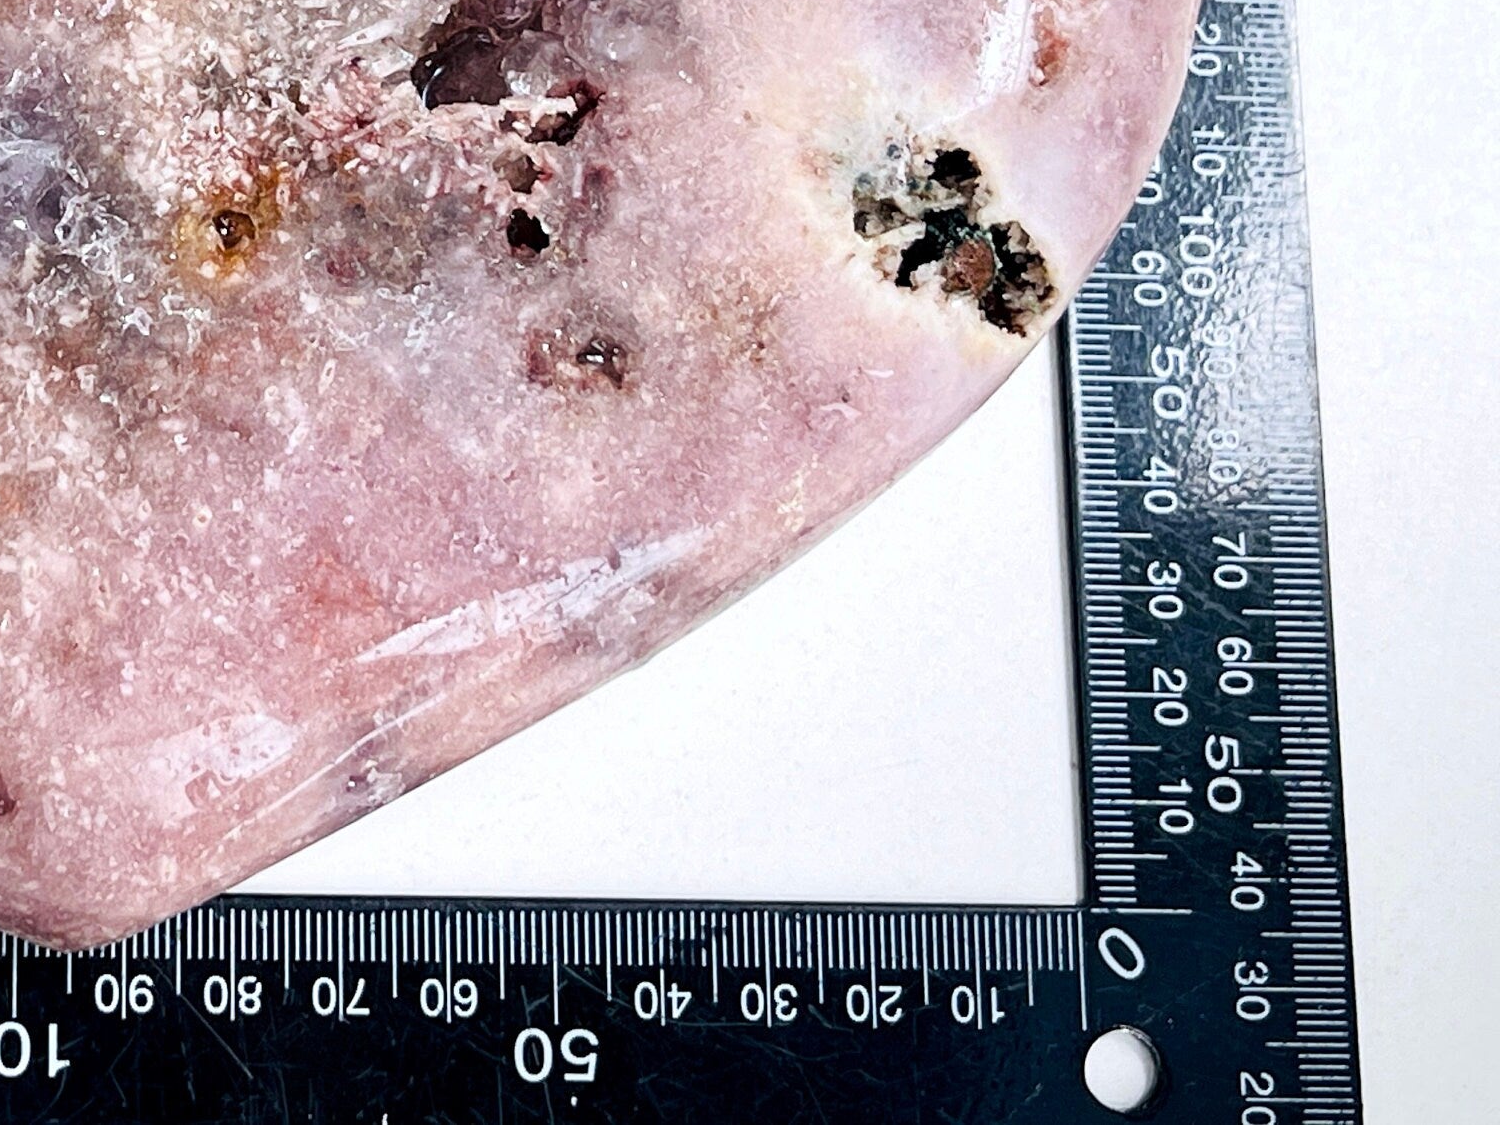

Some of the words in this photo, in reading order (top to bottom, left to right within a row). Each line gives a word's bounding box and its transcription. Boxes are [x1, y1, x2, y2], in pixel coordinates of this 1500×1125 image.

[1189, 22, 1223, 77] 20
[1191, 123, 1227, 178] 10
[1132, 249, 1168, 308] 60
[1179, 204, 1217, 298] 100
[1203, 324, 1238, 379] 90
[1150, 344, 1187, 421] 50
[1207, 429, 1244, 484] 80
[1143, 455, 1178, 515] 40
[1213, 531, 1248, 590] 70
[1147, 560, 1183, 620] 30
[1216, 636, 1254, 696] 60
[1153, 666, 1189, 727] 20
[1205, 734, 1242, 813] 50
[1158, 778, 1195, 835] 10
[1230, 851, 1266, 911] 40
[1098, 927, 1145, 980] 0
[94, 973, 155, 1014] 90
[203, 974, 262, 1015] 80
[312, 976, 370, 1017] 70
[420, 978, 479, 1018] 60
[635, 981, 692, 1019] 40
[740, 983, 798, 1022] 30
[845, 984, 902, 1024] 20
[951, 985, 1005, 1025] 10
[1234, 961, 1271, 1021] 30
[514, 1028, 599, 1082] 50
[1239, 1071, 1277, 1125] 20
